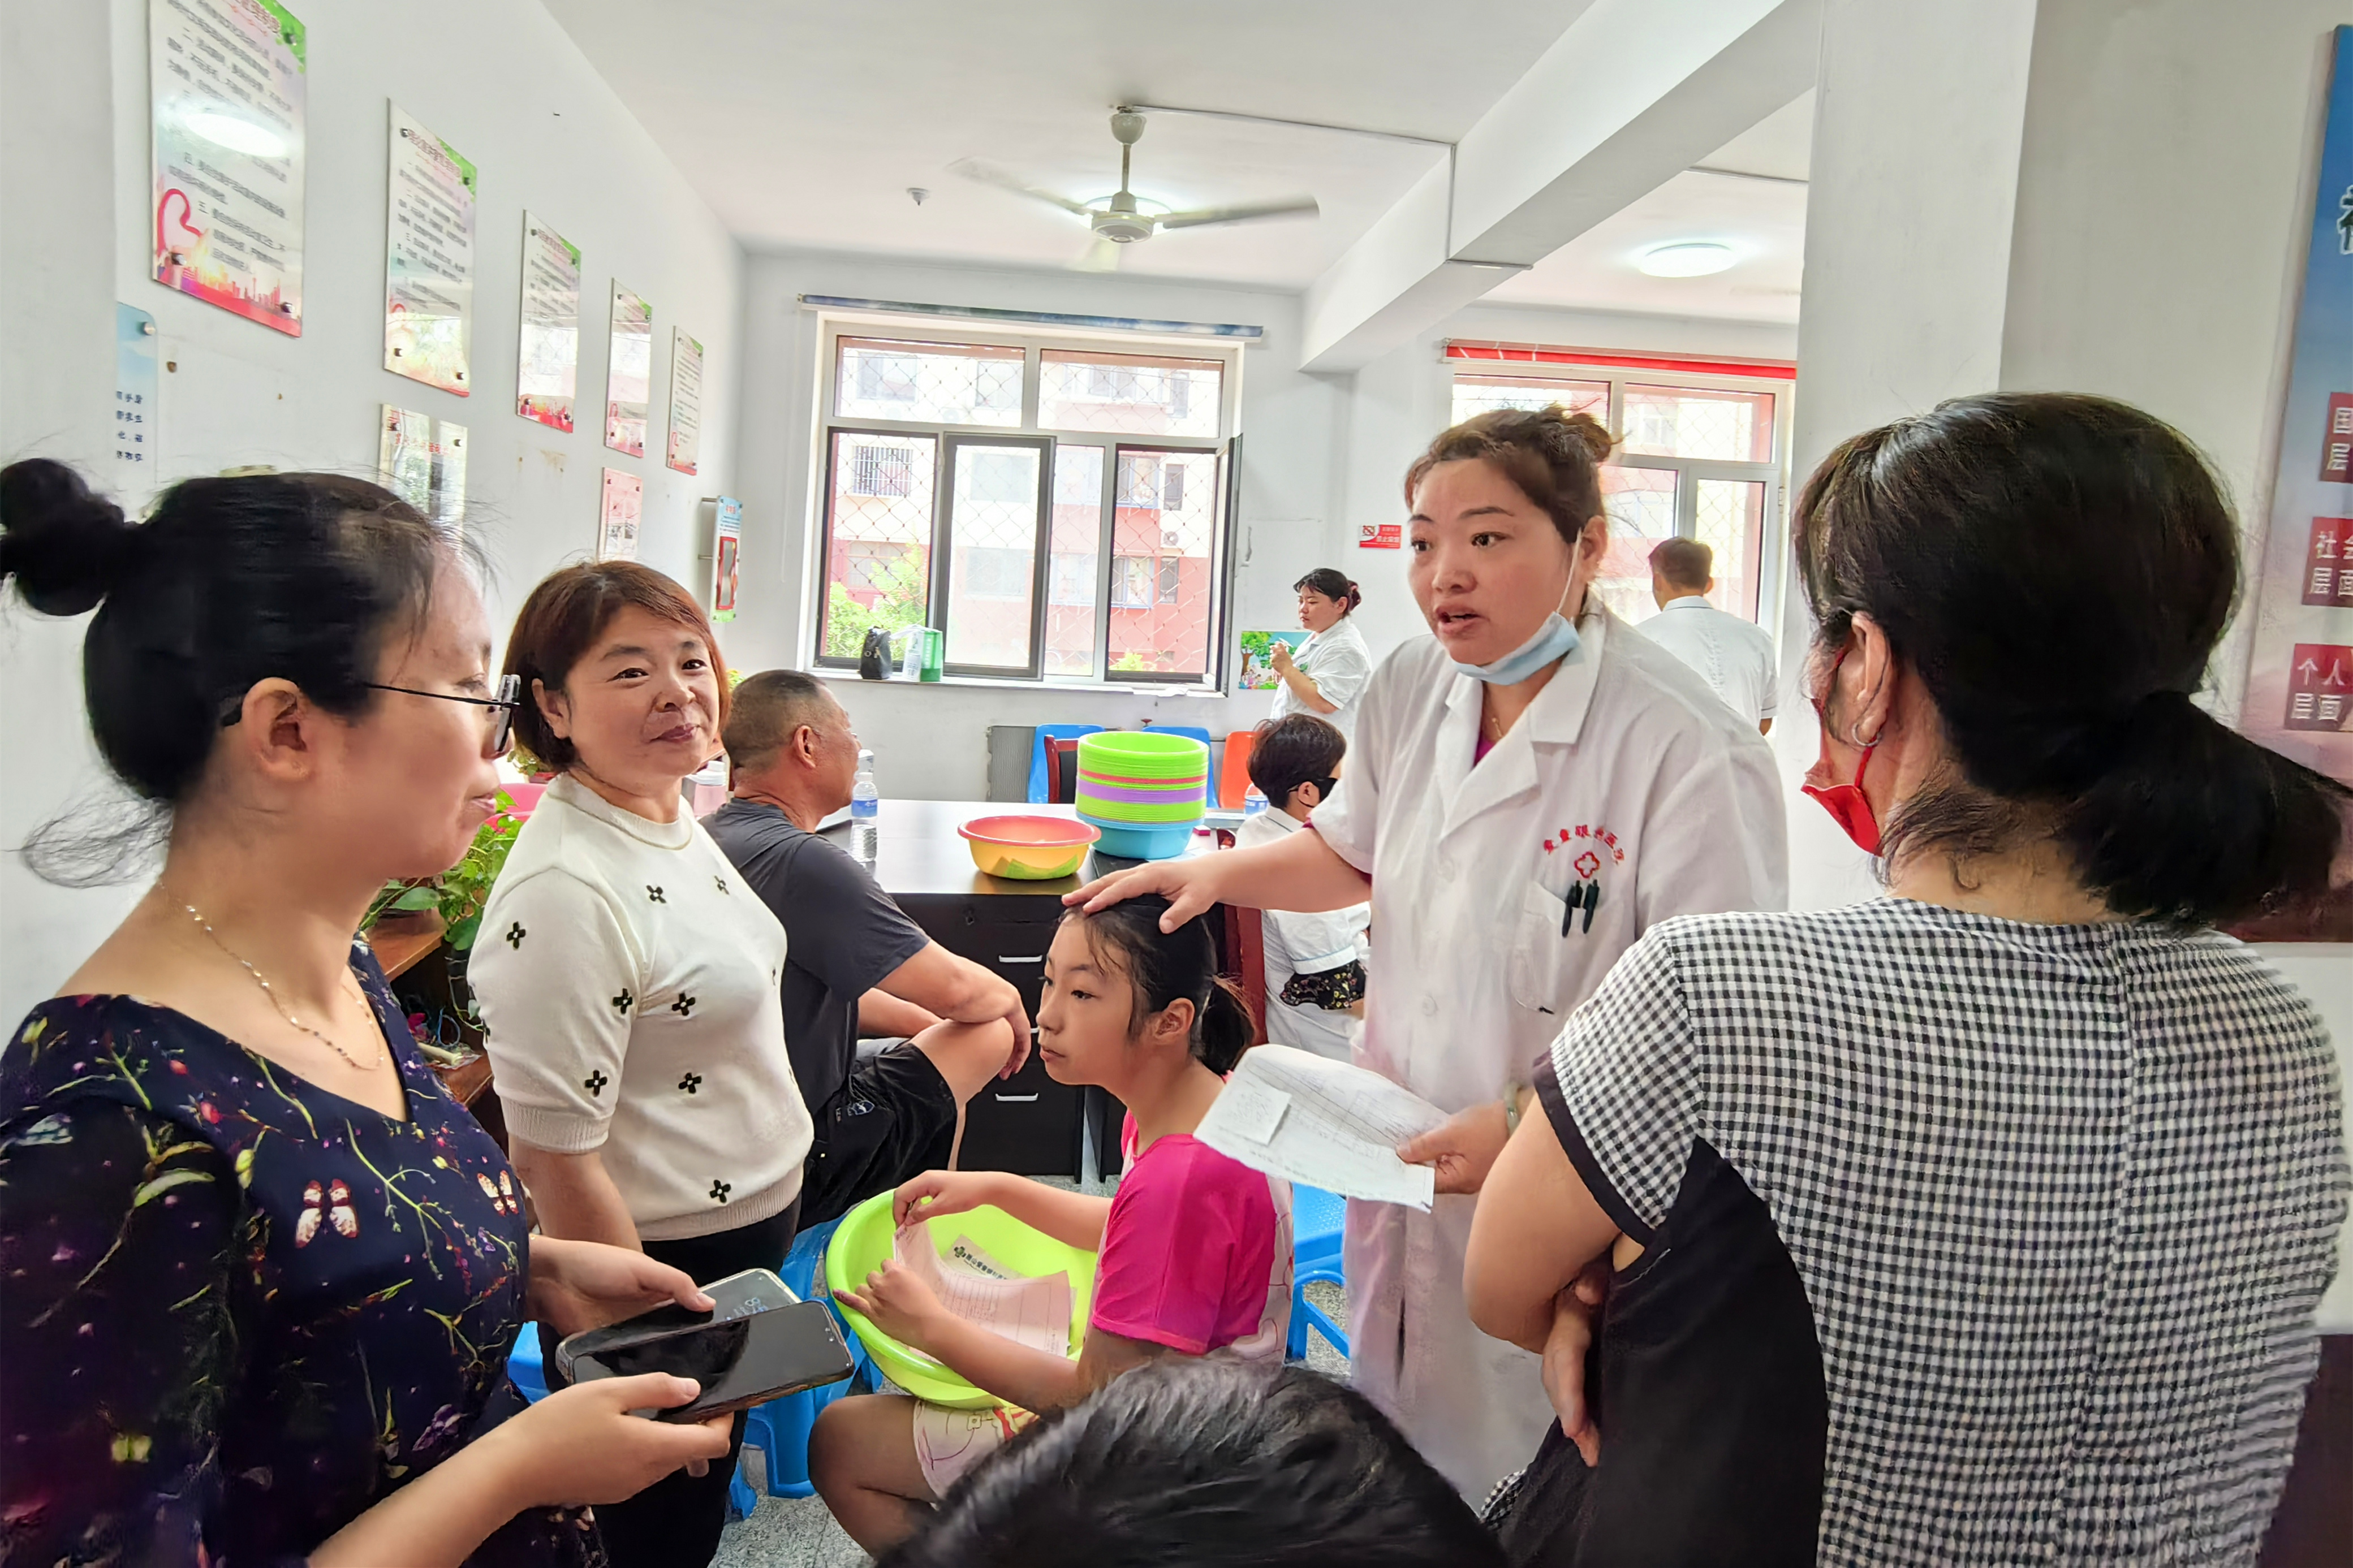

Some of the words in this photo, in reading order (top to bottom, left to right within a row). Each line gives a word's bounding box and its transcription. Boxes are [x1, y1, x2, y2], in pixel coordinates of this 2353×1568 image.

[2326, 442, 2351, 470] 层
[2298, 658, 2346, 686] 个人
[2291, 692, 2339, 722] 层面
